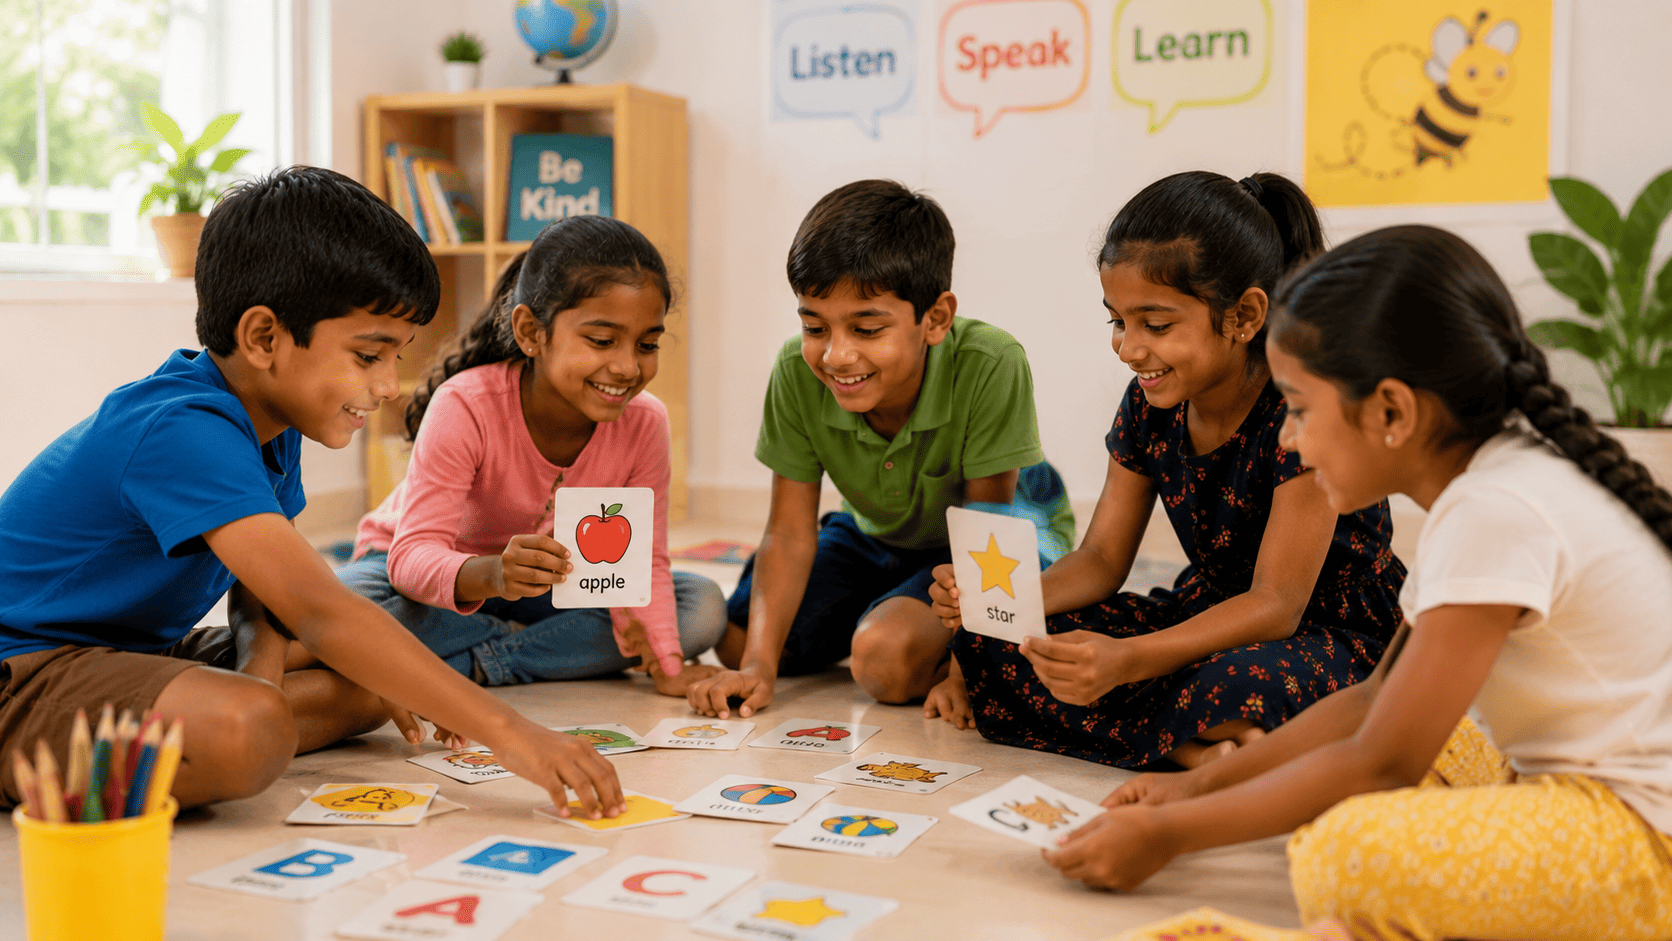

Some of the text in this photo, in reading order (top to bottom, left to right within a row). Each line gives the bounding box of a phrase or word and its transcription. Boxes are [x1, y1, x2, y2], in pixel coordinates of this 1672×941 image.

[956, 28, 1071, 81] Speak
[1133, 26, 1249, 62] Learn
[789, 44, 896, 81] Listen
[538, 149, 583, 184] Be
[520, 186, 600, 220] Kind
[579, 572, 626, 594] apple
[986, 605, 1016, 624] star
[252, 849, 355, 879] B
[621, 869, 708, 897] C
[394, 894, 480, 926] A
